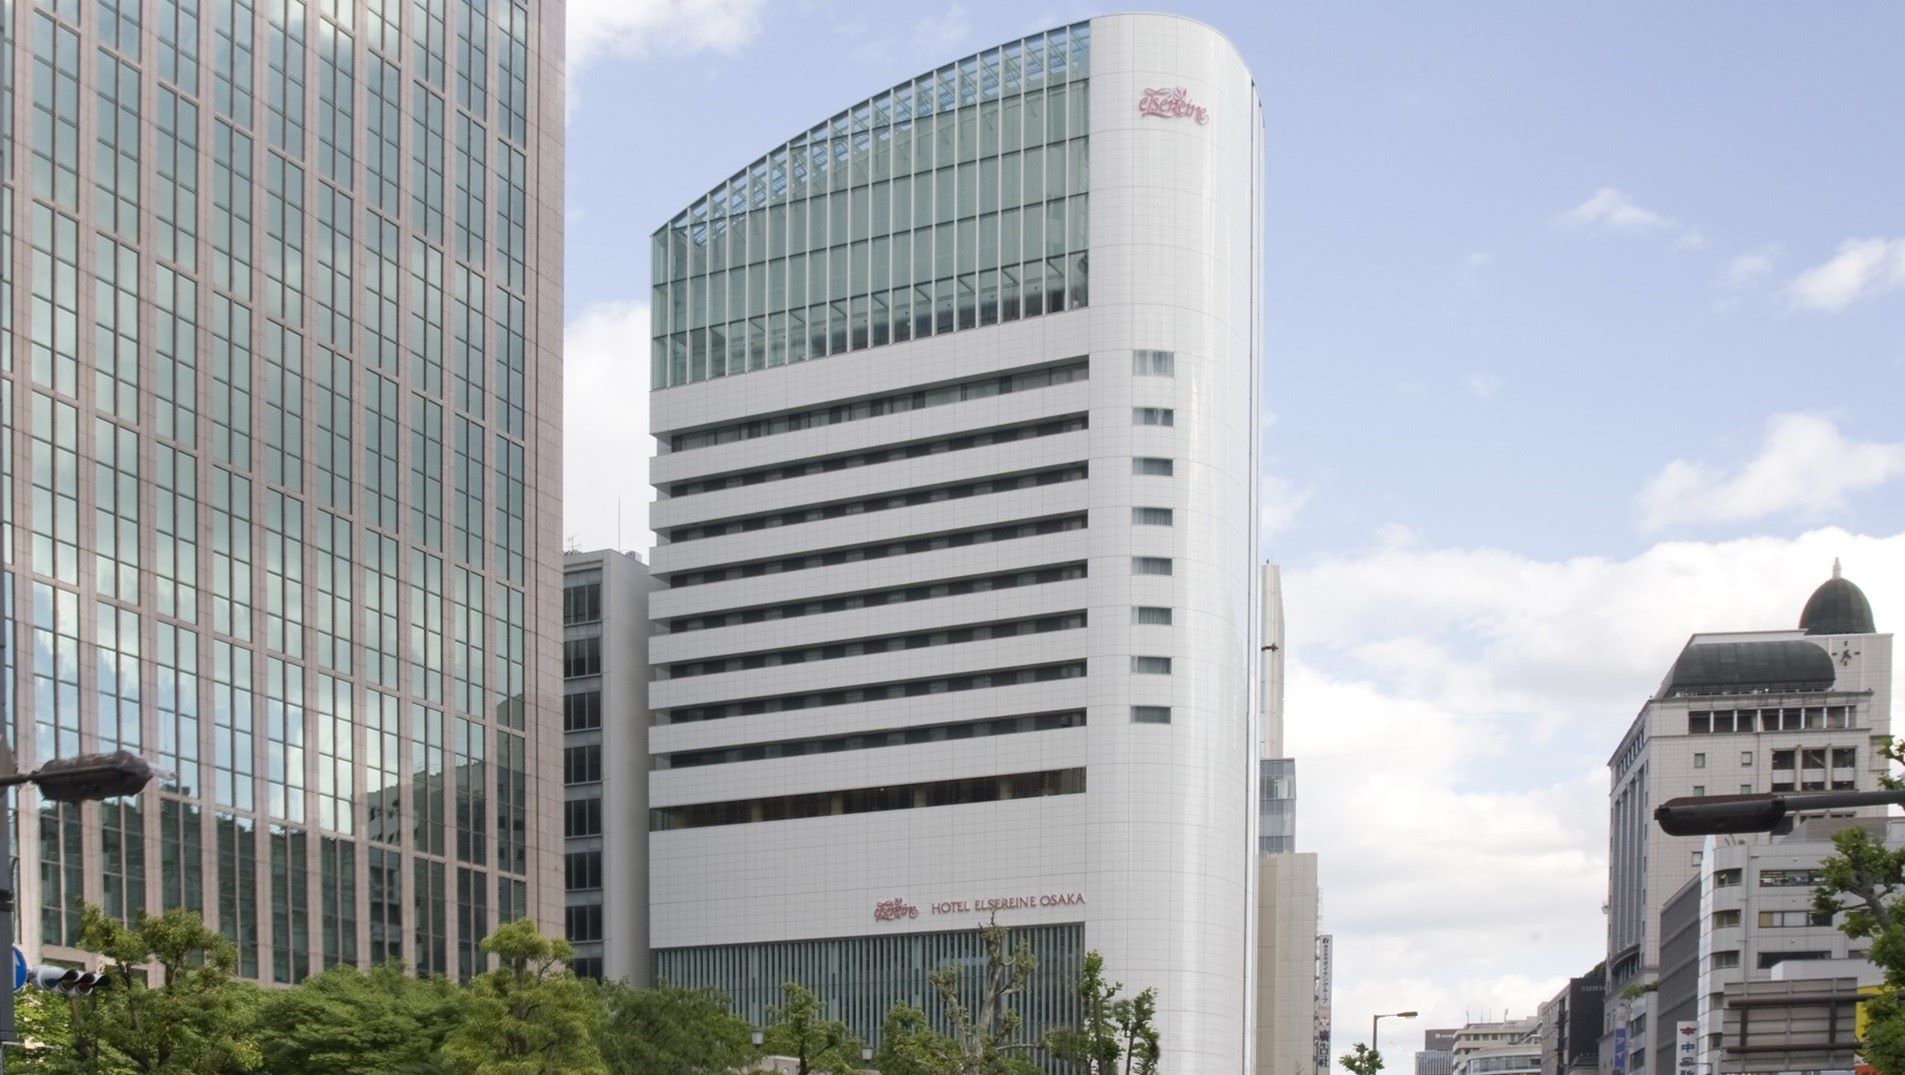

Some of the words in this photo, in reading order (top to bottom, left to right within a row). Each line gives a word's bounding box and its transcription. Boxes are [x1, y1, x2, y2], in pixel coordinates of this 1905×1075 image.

[932, 901, 970, 915] HOTEL
[974, 896, 1037, 912] ELSEREINE
[1039, 892, 1085, 907] OSAKA
